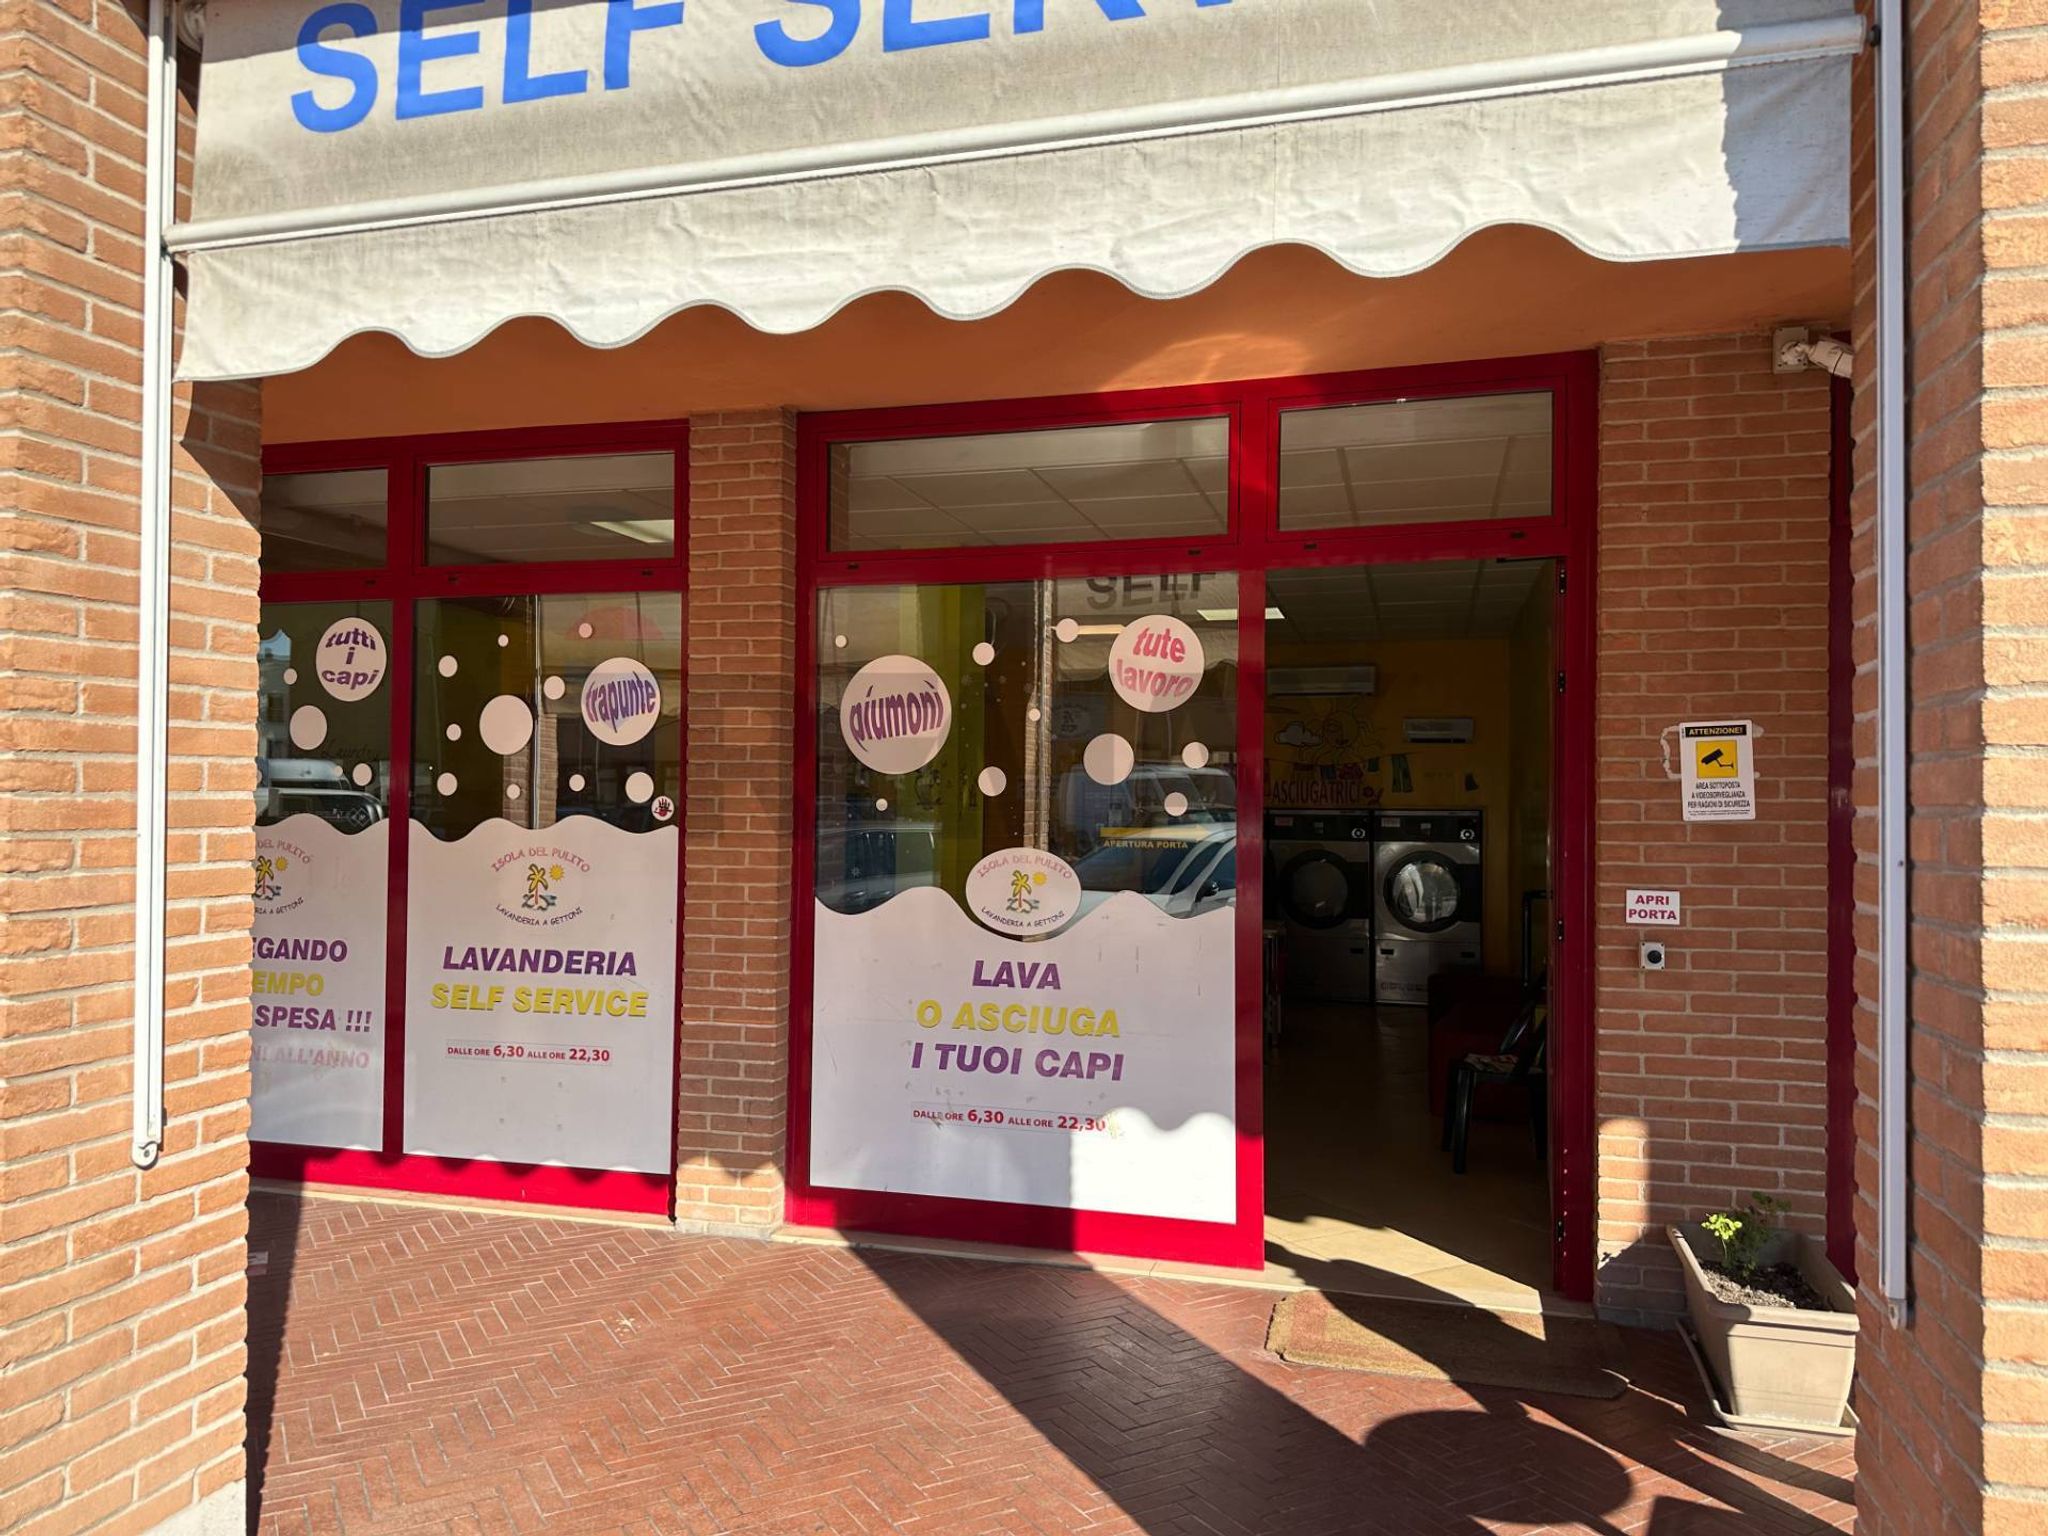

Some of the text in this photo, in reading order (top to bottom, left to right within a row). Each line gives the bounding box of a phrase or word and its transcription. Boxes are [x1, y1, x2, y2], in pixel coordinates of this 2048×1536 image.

[290, 0, 684, 134] SELF
[326, 628, 376, 650] tutti
[1132, 628, 1186, 663] tute
[346, 647, 355, 665] i
[322, 670, 379, 690] capi
[1116, 659, 1194, 697] lavoro
[585, 671, 657, 733] trapunte
[850, 680, 944, 752] piumoni
[1688, 726, 1744, 736] ATTENZIONE!
[1695, 781, 1709, 790] AREA
[1103, 840, 1189, 849] APERTURA PORTA
[491, 847, 590, 873] ISOLA DEL PULITO
[977, 855, 1073, 879] ISOLA DEL PULITO
[1635, 894, 1670, 906] APRI
[496, 903, 540, 926] LAVANDERIA
[550, 906, 584, 926] GETTONI
[981, 906, 1024, 927] LAVANDERIA
[1628, 908, 1677, 920] PORTA
[252, 937, 348, 962] GANDO
[443, 946, 637, 976] LAVANDERIA
[972, 960, 1061, 990] LAVA
[431, 983, 649, 1018] SELF SERVICE
[254, 1004, 336, 1031] SPESA
[916, 999, 1121, 1038] O ASCIUGA
[447, 1045, 610, 1063] DALLE ORE 6,30 ALLE ORE 22,30
[911, 1042, 1124, 1081] I TUOI CAPI
[945, 1112, 964, 1121] ORE
[967, 1109, 1004, 1124] 6,30
[1008, 1117, 1032, 1126] ALLE
[1033, 1118, 1053, 1128] ORE
[1057, 1115, 1106, 1132] 22,30
